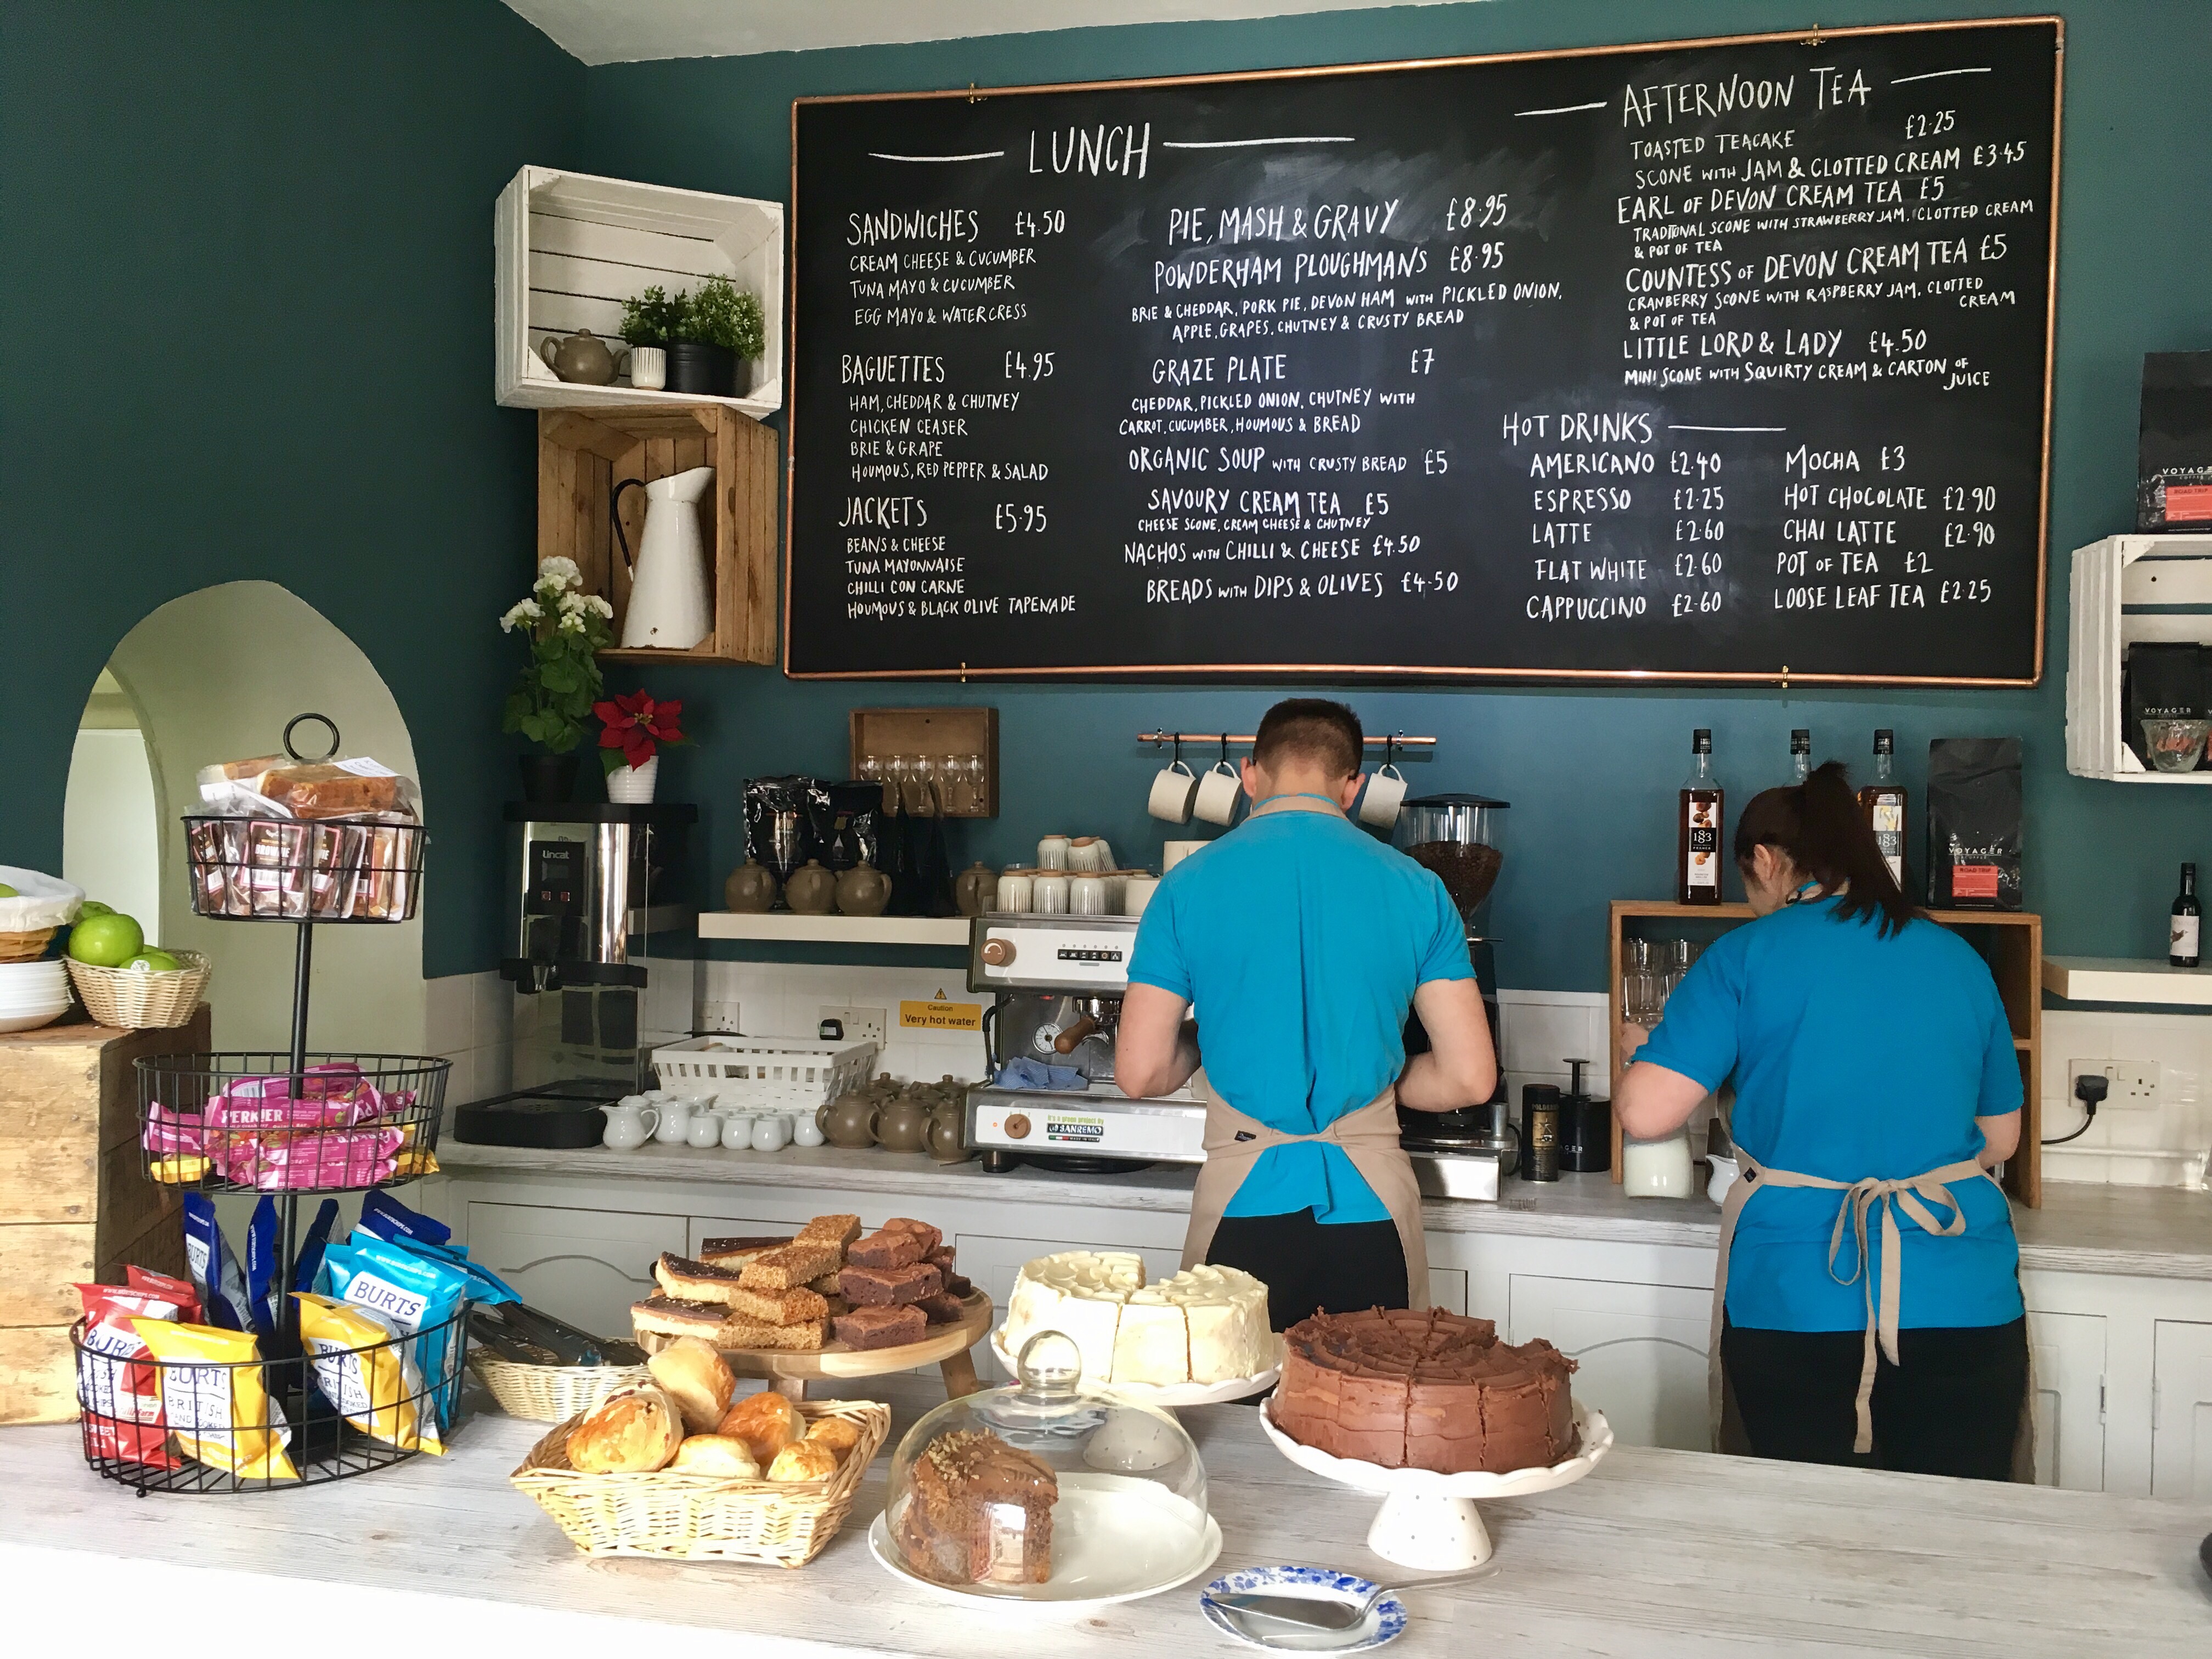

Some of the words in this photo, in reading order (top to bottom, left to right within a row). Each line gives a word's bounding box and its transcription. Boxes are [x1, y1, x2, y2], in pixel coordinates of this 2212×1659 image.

[1624, 73, 1795, 128] AFTERNOON
[1809, 66, 1872, 110] TEA
[1029, 122, 1150, 179] LUNCH
[1630, 136, 1705, 161] TOASTED
[1714, 129, 1795, 154] TEACAKE
[1905, 110, 1956, 140] £2.25
[1618, 195, 1675, 224] EARL
[1683, 196, 1703, 214] OF
[1711, 184, 1777, 212] DEVON
[1786, 184, 1854, 208] CREAM
[1864, 179, 1903, 204] TEA
[1920, 176, 1945, 201] £5
[847, 208, 979, 246] SANDWICHES
[1015, 210, 1065, 238] £4.50
[1219, 205, 1284, 244] MASH
[1292, 207, 1307, 238] &
[1314, 199, 1400, 241] GRAVY
[1446, 193, 1508, 232] £8.95
[1709, 218, 1751, 235] SCONE
[1757, 217, 1788, 230] WITH
[1792, 211, 1875, 229] STRAWBERRY
[1917, 205, 1978, 221] CLOTTED
[1985, 199, 2033, 217] CREAM
[850, 252, 898, 274] CREAM
[904, 251, 949, 271] CHEESE
[956, 250, 966, 266] &
[969, 248, 1036, 269] CUCUMBER
[1634, 246, 1644, 259] &
[1649, 244, 1671, 258] POT
[1675, 243, 1689, 255] OF
[1694, 239, 1723, 254] TEA
[1155, 256, 1282, 295] POWDERHAM
[1295, 246, 1427, 284] PLOUGHMANS
[1450, 241, 1505, 273] £8.95
[849, 280, 884, 300] TUNA
[888, 279, 926, 301] MAYO
[930, 277, 939, 293] &
[943, 274, 1015, 295] CUCUMBER
[1277, 315, 1338, 334] CHUTNEY
[1340, 315, 1350, 330] &
[1358, 311, 1409, 329] CRUSTY
[1417, 308, 1464, 328] BREAD
[1624, 335, 1689, 360] LITTLE
[1701, 331, 1754, 358] LORD
[1758, 331, 1774, 355] &
[1785, 329, 1842, 358] LADY
[1869, 329, 1927, 358] £4.50
[842, 354, 945, 386] BAGUETTES
[1005, 350, 1056, 381] £4.95
[1152, 357, 1215, 387] GRAZE
[1227, 354, 1287, 383] PLATE
[1411, 348, 1435, 375] £7
[1624, 368, 1657, 386] MINI
[1660, 366, 1702, 388] SCONE
[1709, 367, 1740, 381] WITH
[1744, 362, 1813, 382] SQUIRTY
[1818, 361, 1867, 382] CREAM
[1872, 363, 1883, 377] &
[1888, 358, 1947, 377] CARTON
[1955, 357, 1969, 369] OF
[1943, 371, 1990, 391] JUICE
[886, 393, 943, 414] CHEDDAR
[947, 393, 956, 411] &
[961, 392, 1020, 411] CHUTNEY
[1200, 393, 1252, 411] PICKLED
[1309, 387, 1372, 408] CHUTNEY
[1380, 392, 1415, 405] WITH
[850, 417, 911, 438] CHICKEN
[917, 418, 968, 436] CEASER
[1503, 411, 1550, 446] HOT
[1560, 411, 1652, 444] DRINKS
[1530, 451, 1655, 479] AMERICANO
[1669, 450, 1721, 481] £2.40
[1786, 444, 1860, 479] MOCHA
[1880, 445, 1905, 471] £3
[2162, 466, 2212, 475] VOYAGE
[1148, 487, 1230, 515] SAVOURY
[1239, 490, 1301, 518] CREAM
[1307, 492, 1341, 516] TEA
[1365, 492, 1389, 516] £5
[1534, 487, 1632, 515] ESPRESSO
[1673, 486, 1724, 511] £2.25
[1785, 483, 1820, 511] HOT
[1828, 486, 1927, 510] CHOCOLATE
[1943, 486, 1996, 514] £2.90
[838, 496, 927, 530] JACKETS
[995, 503, 1047, 533] £5.95
[1138, 517, 1179, 533] CHEESE
[1223, 518, 1259, 535] CREAM
[1262, 518, 1301, 532] CHEESE
[1304, 518, 1311, 530] &
[1316, 516, 1371, 532] CHUTNEY
[1532, 521, 1592, 549] LATTE
[1675, 518, 1724, 542] £2.60
[845, 559, 881, 575] TUNA
[884, 557, 966, 575] MAYONNAISE
[847, 580, 884, 596] CHILLI
[890, 580, 916, 594] CON
[921, 579, 965, 595] CARNE
[905, 1014, 927, 1025] Very
[929, 1015, 946, 1024] hot
[948, 1017, 976, 1026] water
[1059, 1124, 1102, 1134] SANREMO
[353, 1280, 422, 1316] BURTS
[168, 1396, 223, 1419] BRITISH
